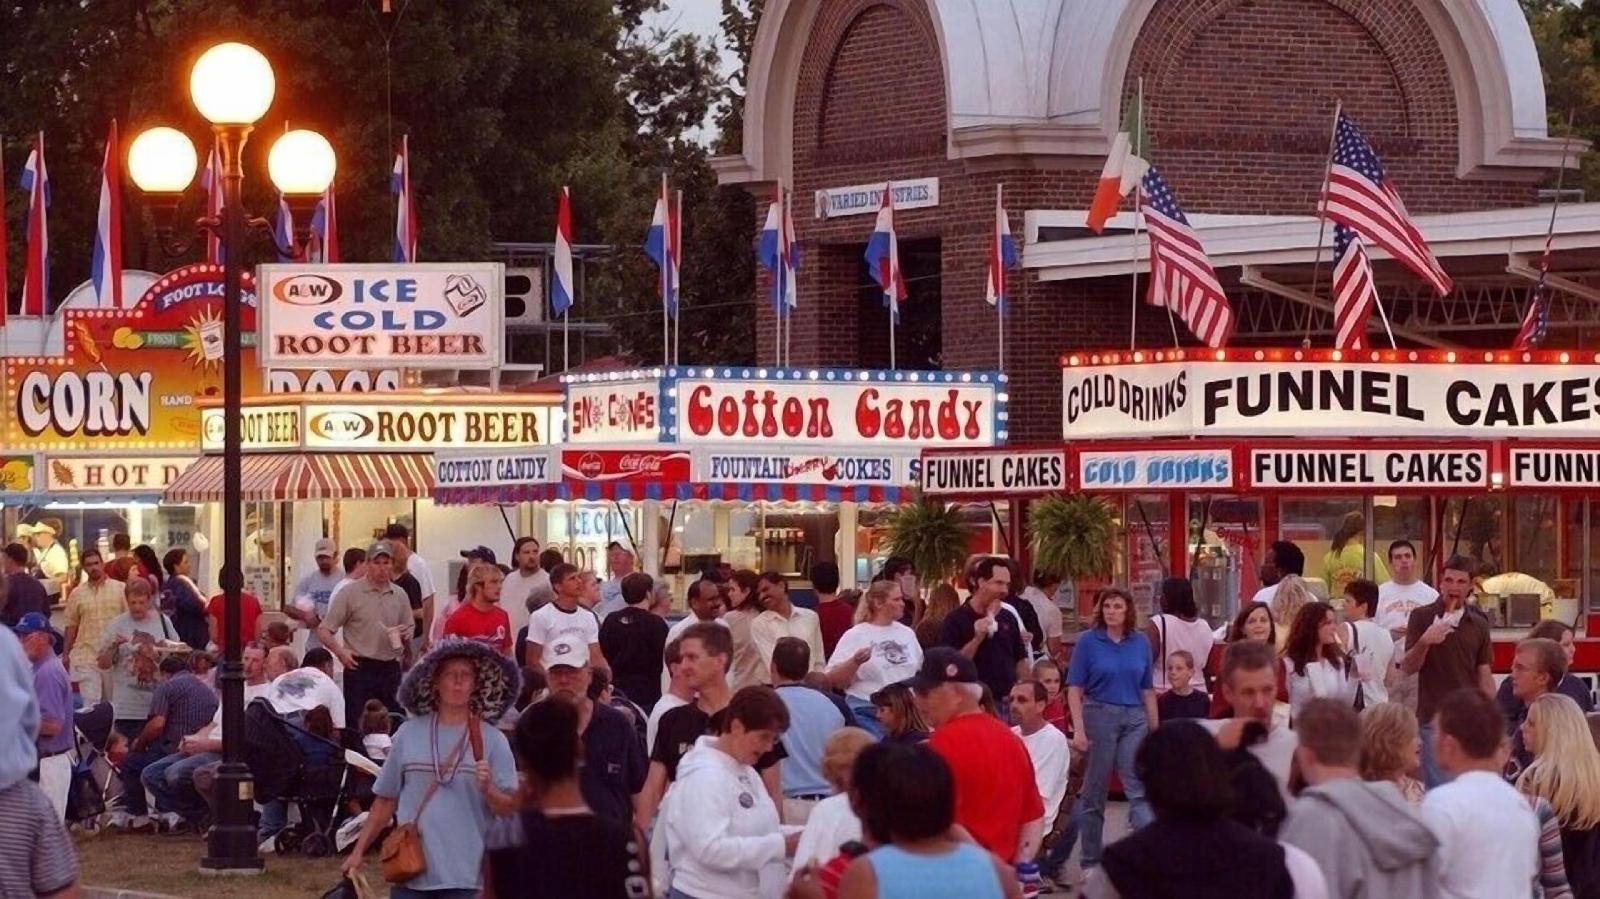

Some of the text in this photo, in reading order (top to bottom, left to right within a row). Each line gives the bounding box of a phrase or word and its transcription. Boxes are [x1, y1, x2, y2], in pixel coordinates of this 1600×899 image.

[870, 185, 929, 206] INSTRIES
[163, 282, 204, 309] FOOT
[353, 279, 417, 303] ICE
[313, 310, 447, 331] COLD
[275, 334, 375, 355] ROOT
[390, 334, 485, 355] BEER
[19, 371, 152, 436] CORN
[687, 385, 983, 440] Cotton Candy
[1067, 370, 1187, 425] COLD DRINKS
[1204, 370, 1600, 426] FUNNEL CAKE
[267, 411, 299, 442] BEER
[377, 411, 456, 443] ROOT
[465, 411, 539, 443] BEER
[84, 465, 150, 487] HOT
[438, 457, 548, 483] COTTON CANDY
[711, 456, 791, 480] FOUNTAIN
[836, 457, 891, 480] COKES
[926, 455, 1062, 489] FUNNEL CAKES
[1083, 454, 1230, 485] COLD DRINKS
[1255, 453, 1482, 484] FUNNEL CAKES
[1515, 453, 1600, 483] FUNN
